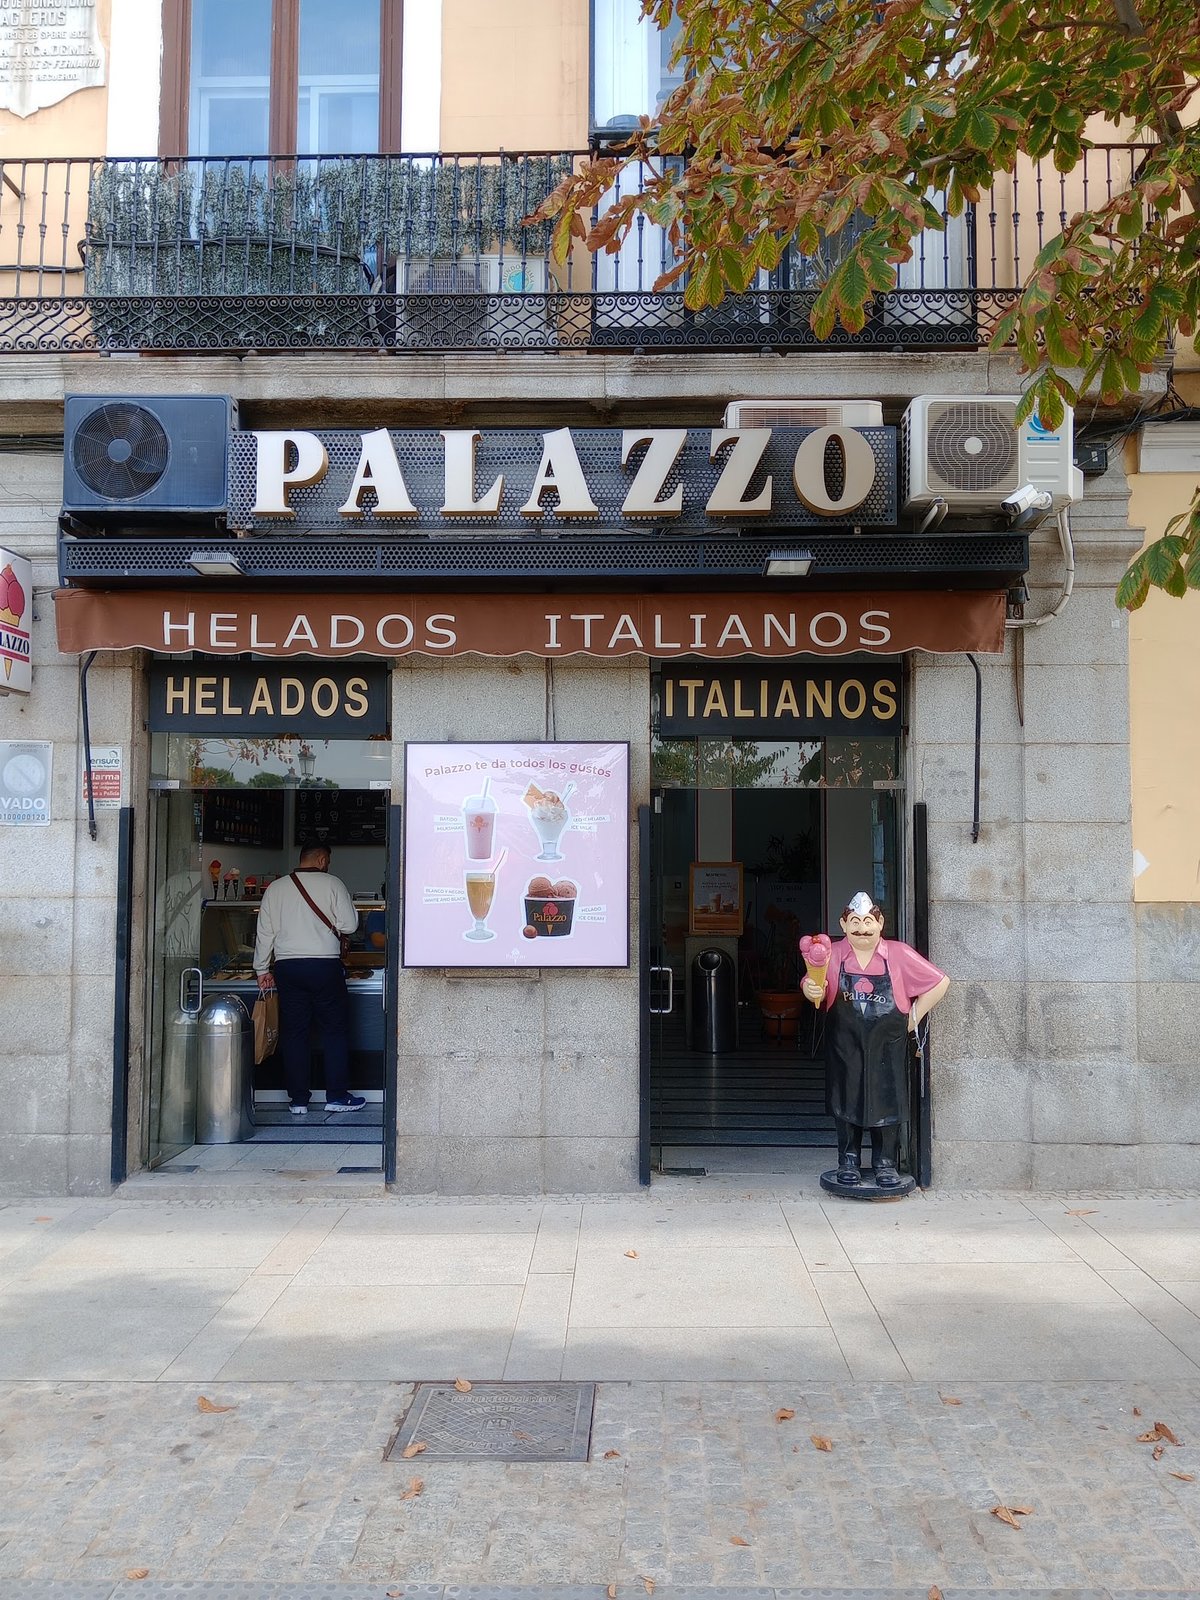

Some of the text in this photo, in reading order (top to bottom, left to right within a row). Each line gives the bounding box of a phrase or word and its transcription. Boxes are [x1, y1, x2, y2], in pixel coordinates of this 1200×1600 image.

[250, 425, 876, 517] PALAZZO
[163, 610, 892, 649] HELADOS ITALIANOS
[165, 676, 369, 718] HELADOS
[665, 679, 898, 720] ITALIANOS
[424, 759, 612, 778] Palazzo te da todos los gustos
[0, 797, 46, 810] VADO
[842, 990, 887, 1004] Palazzo
